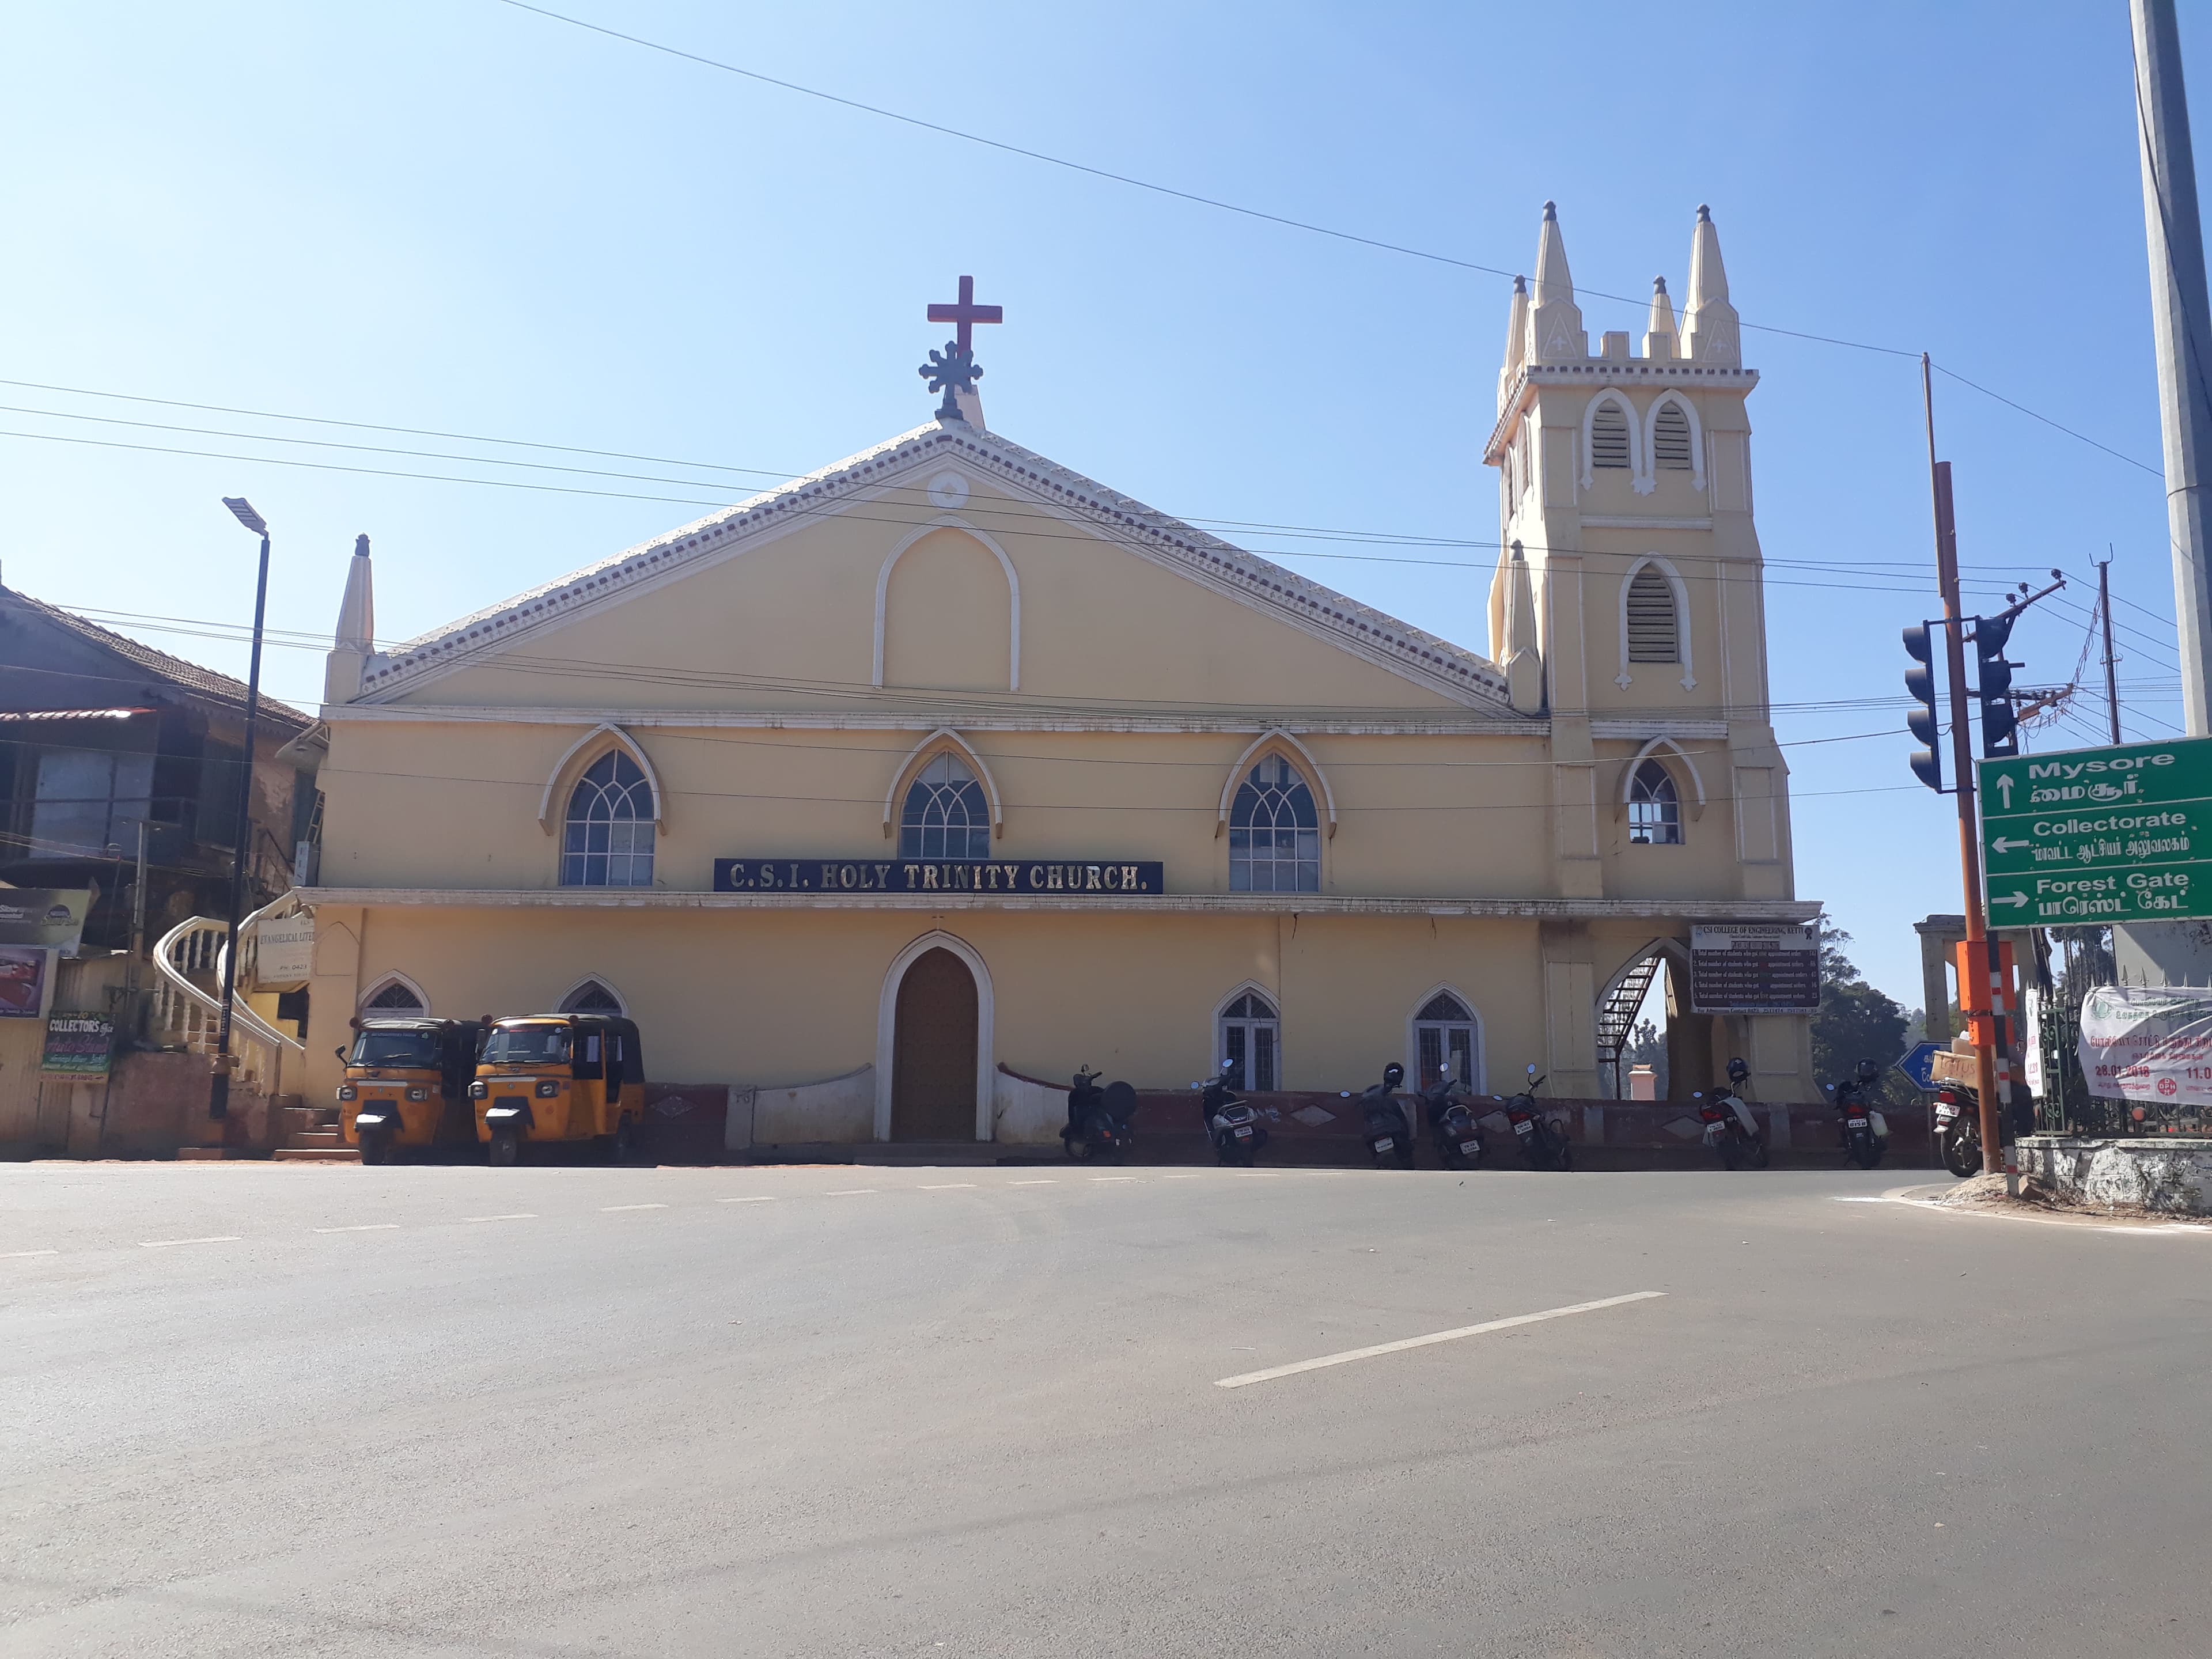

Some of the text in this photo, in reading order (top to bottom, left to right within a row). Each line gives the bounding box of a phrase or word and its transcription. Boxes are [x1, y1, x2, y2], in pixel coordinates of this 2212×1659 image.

[2029, 754, 2175, 779] Mysore
[2033, 812, 2186, 836] Collectorate
[2125, 831, 2189, 858] அலுவலகம்
[730, 863, 1147, 891] C.S.I. HOLY TRINITY CHURCH.
[2037, 872, 2189, 894] Forest Gate
[2137, 889, 2189, 910] கேட்
[260, 933, 297, 945] EVANGELICAL
[2095, 1064, 2150, 1078] 28.01.2018
